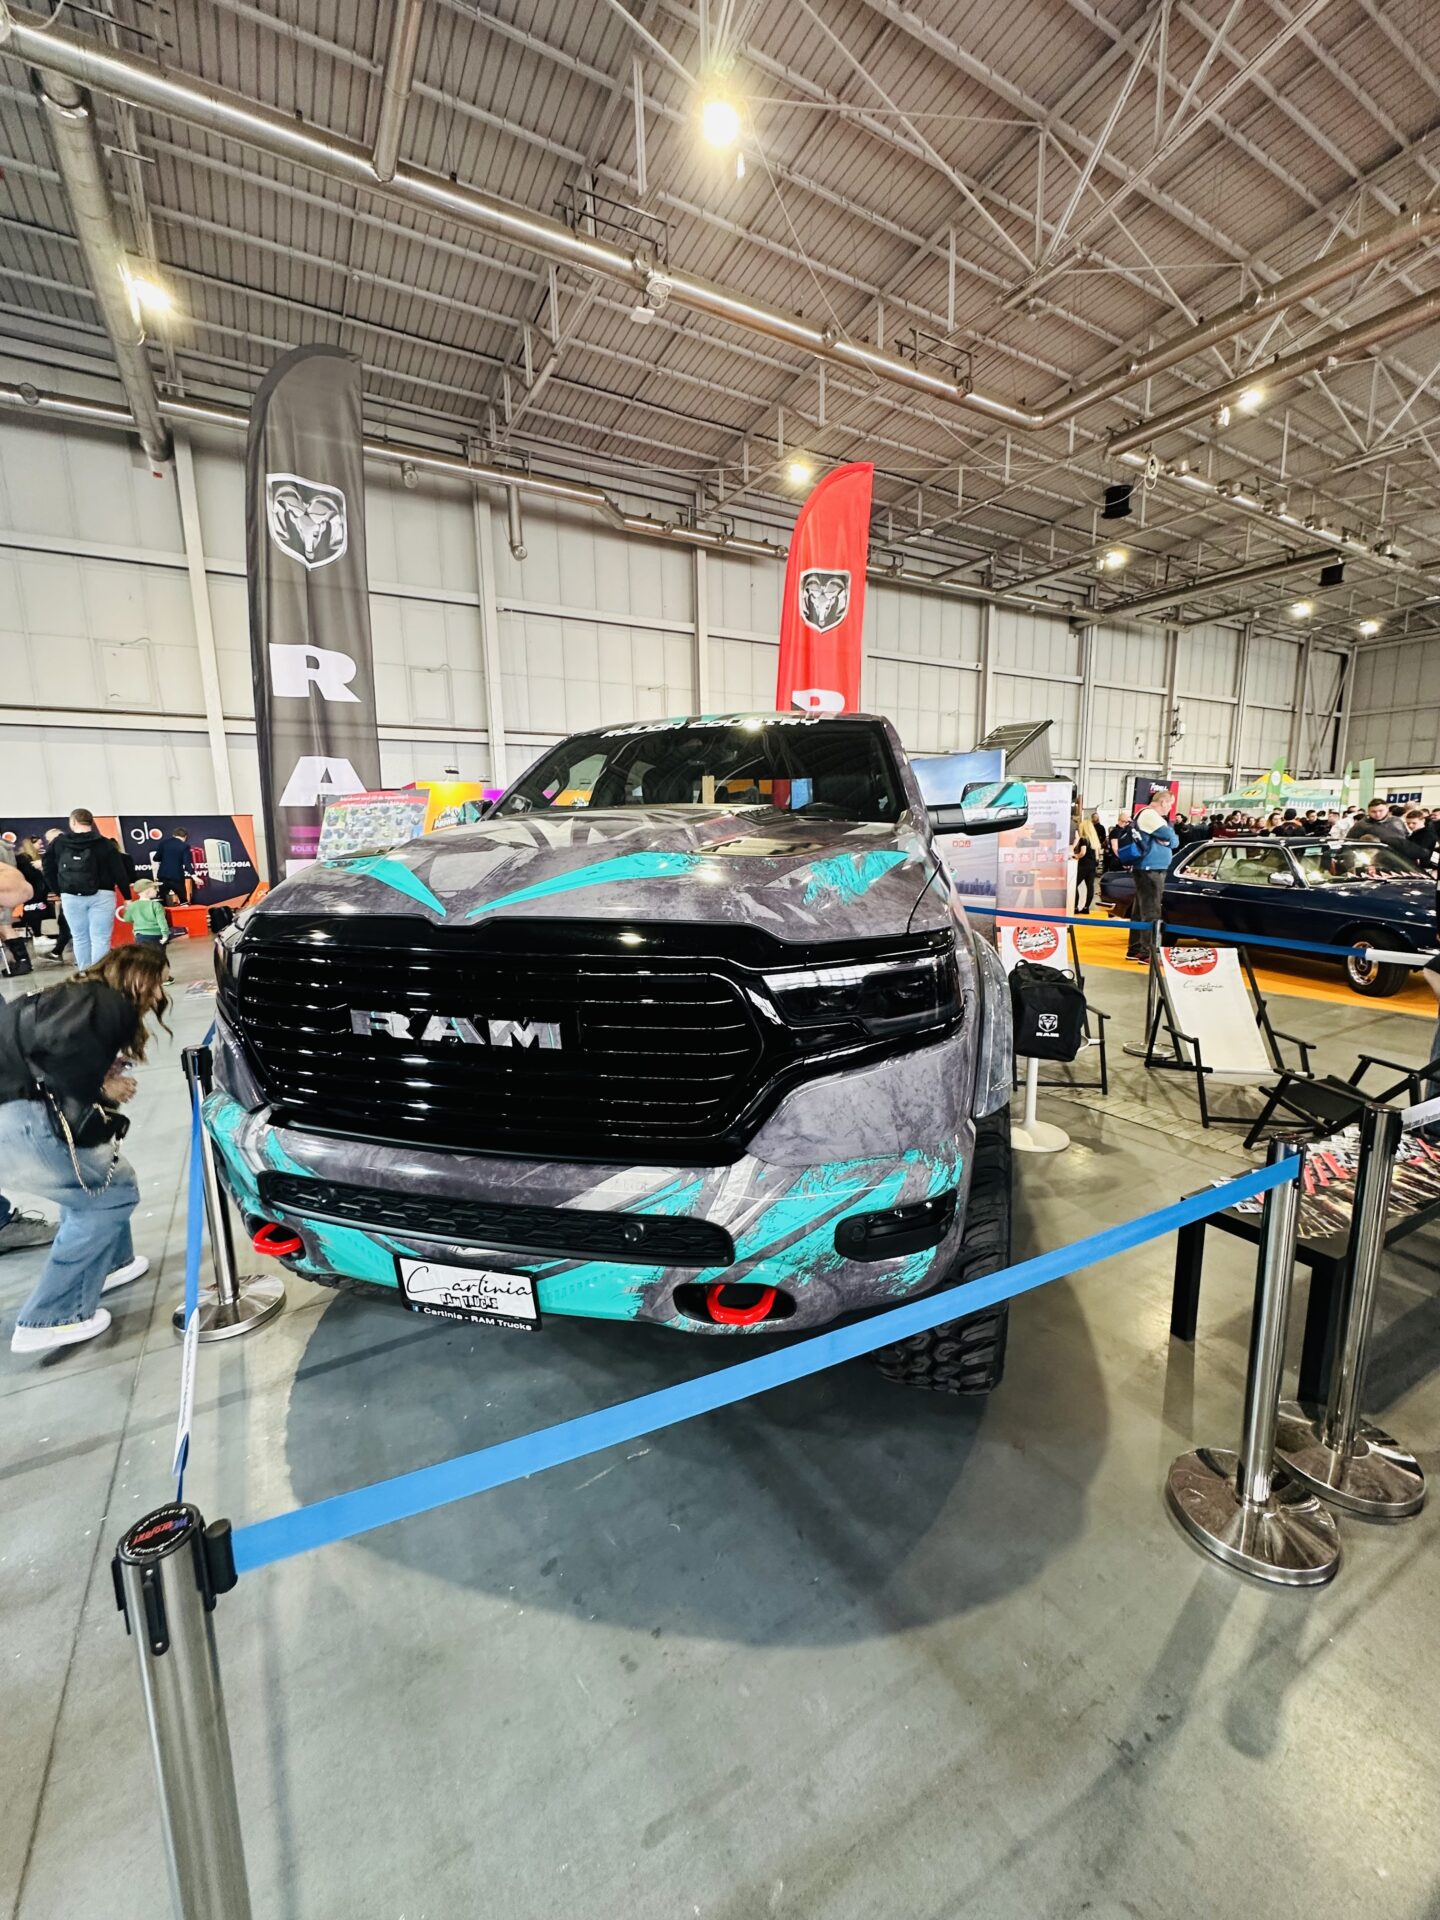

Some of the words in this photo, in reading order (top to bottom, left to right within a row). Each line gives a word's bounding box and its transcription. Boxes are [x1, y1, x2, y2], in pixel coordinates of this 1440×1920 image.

[600, 721, 685, 739] ROUGH
[686, 717, 821, 731] COUNTRY
[130, 821, 163, 845] glo
[195, 861, 251, 869] TECOLOGIA
[350, 1008, 563, 1050] RAM
[407, 1265, 533, 1296] Cartinia
[461, 1294, 499, 1310] TRUCKS
[423, 1306, 463, 1320] Cartinia
[470, 1315, 496, 1325] RAM
[496, 1319, 533, 1331] Trucks
